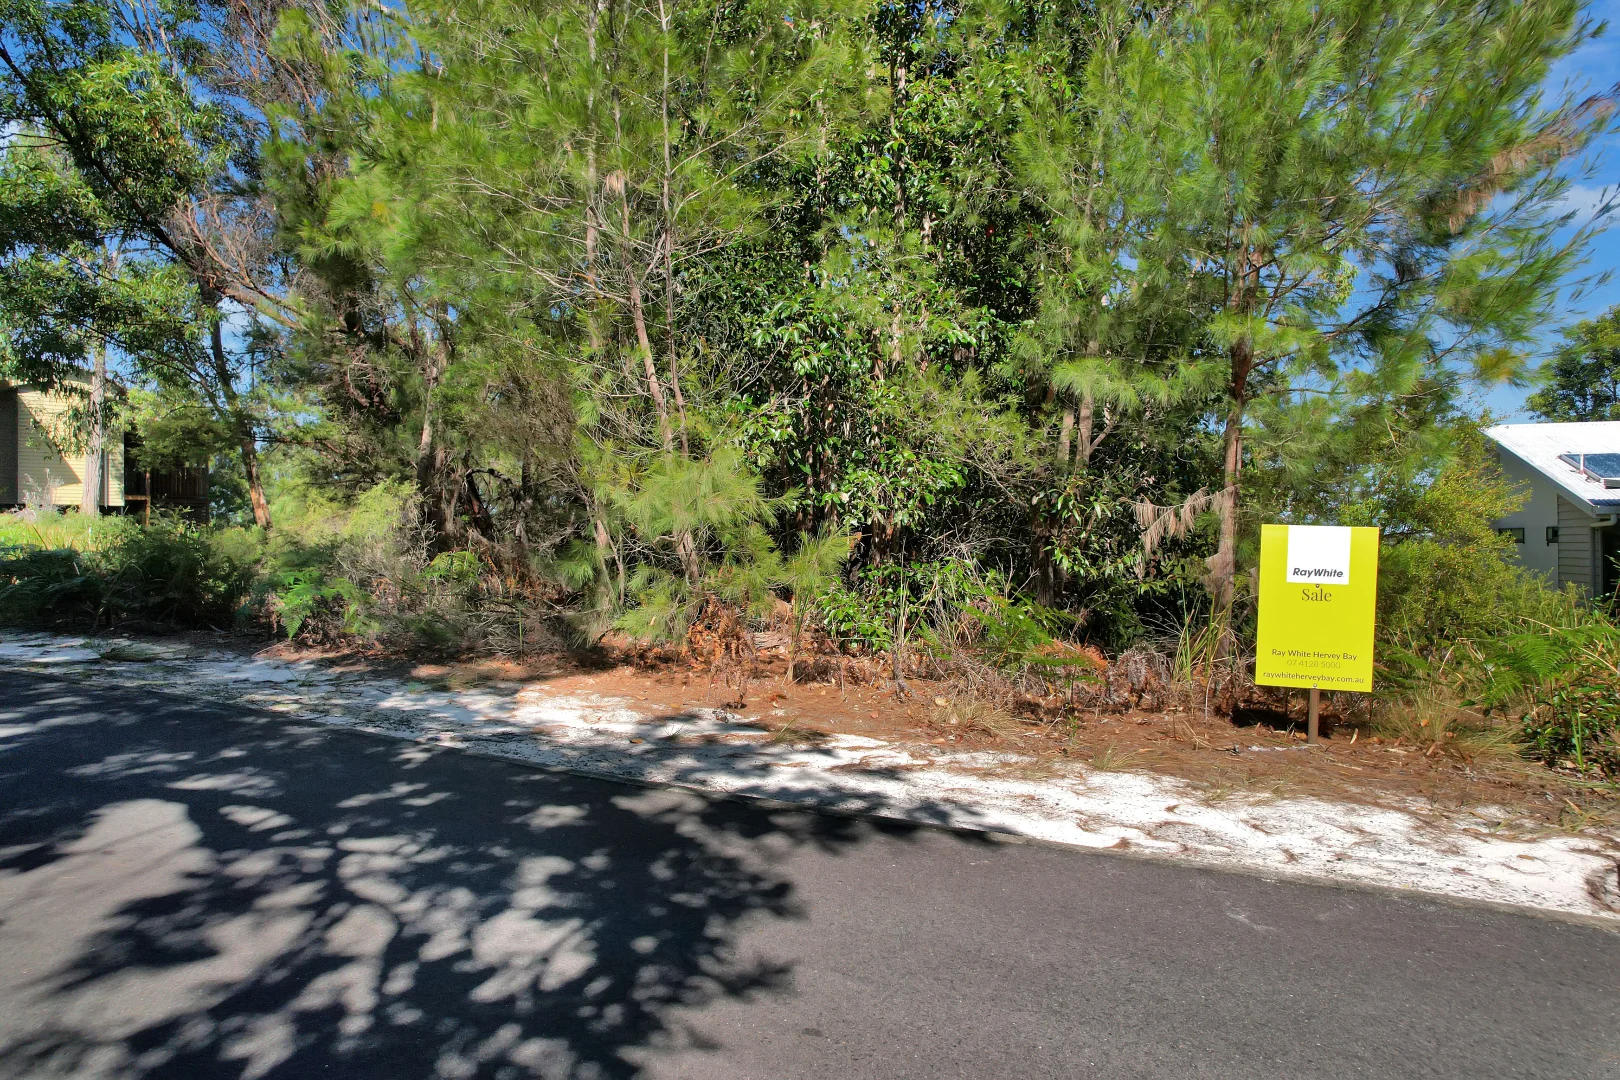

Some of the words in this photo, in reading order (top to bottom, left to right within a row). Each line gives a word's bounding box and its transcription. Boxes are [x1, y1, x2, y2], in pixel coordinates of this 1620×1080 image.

[1301, 588, 1332, 602] Sale
[1272, 649, 1286, 657] Ray
[1288, 649, 1311, 658] White
[1313, 651, 1341, 660] Hervey
[1342, 652, 1358, 661] Bay
[1287, 659, 1297, 667] 07
[1299, 660, 1318, 668] 4128
[1321, 661, 1341, 669] 5000
[1263, 671, 1364, 684] raywhiteherveybay.com.au
